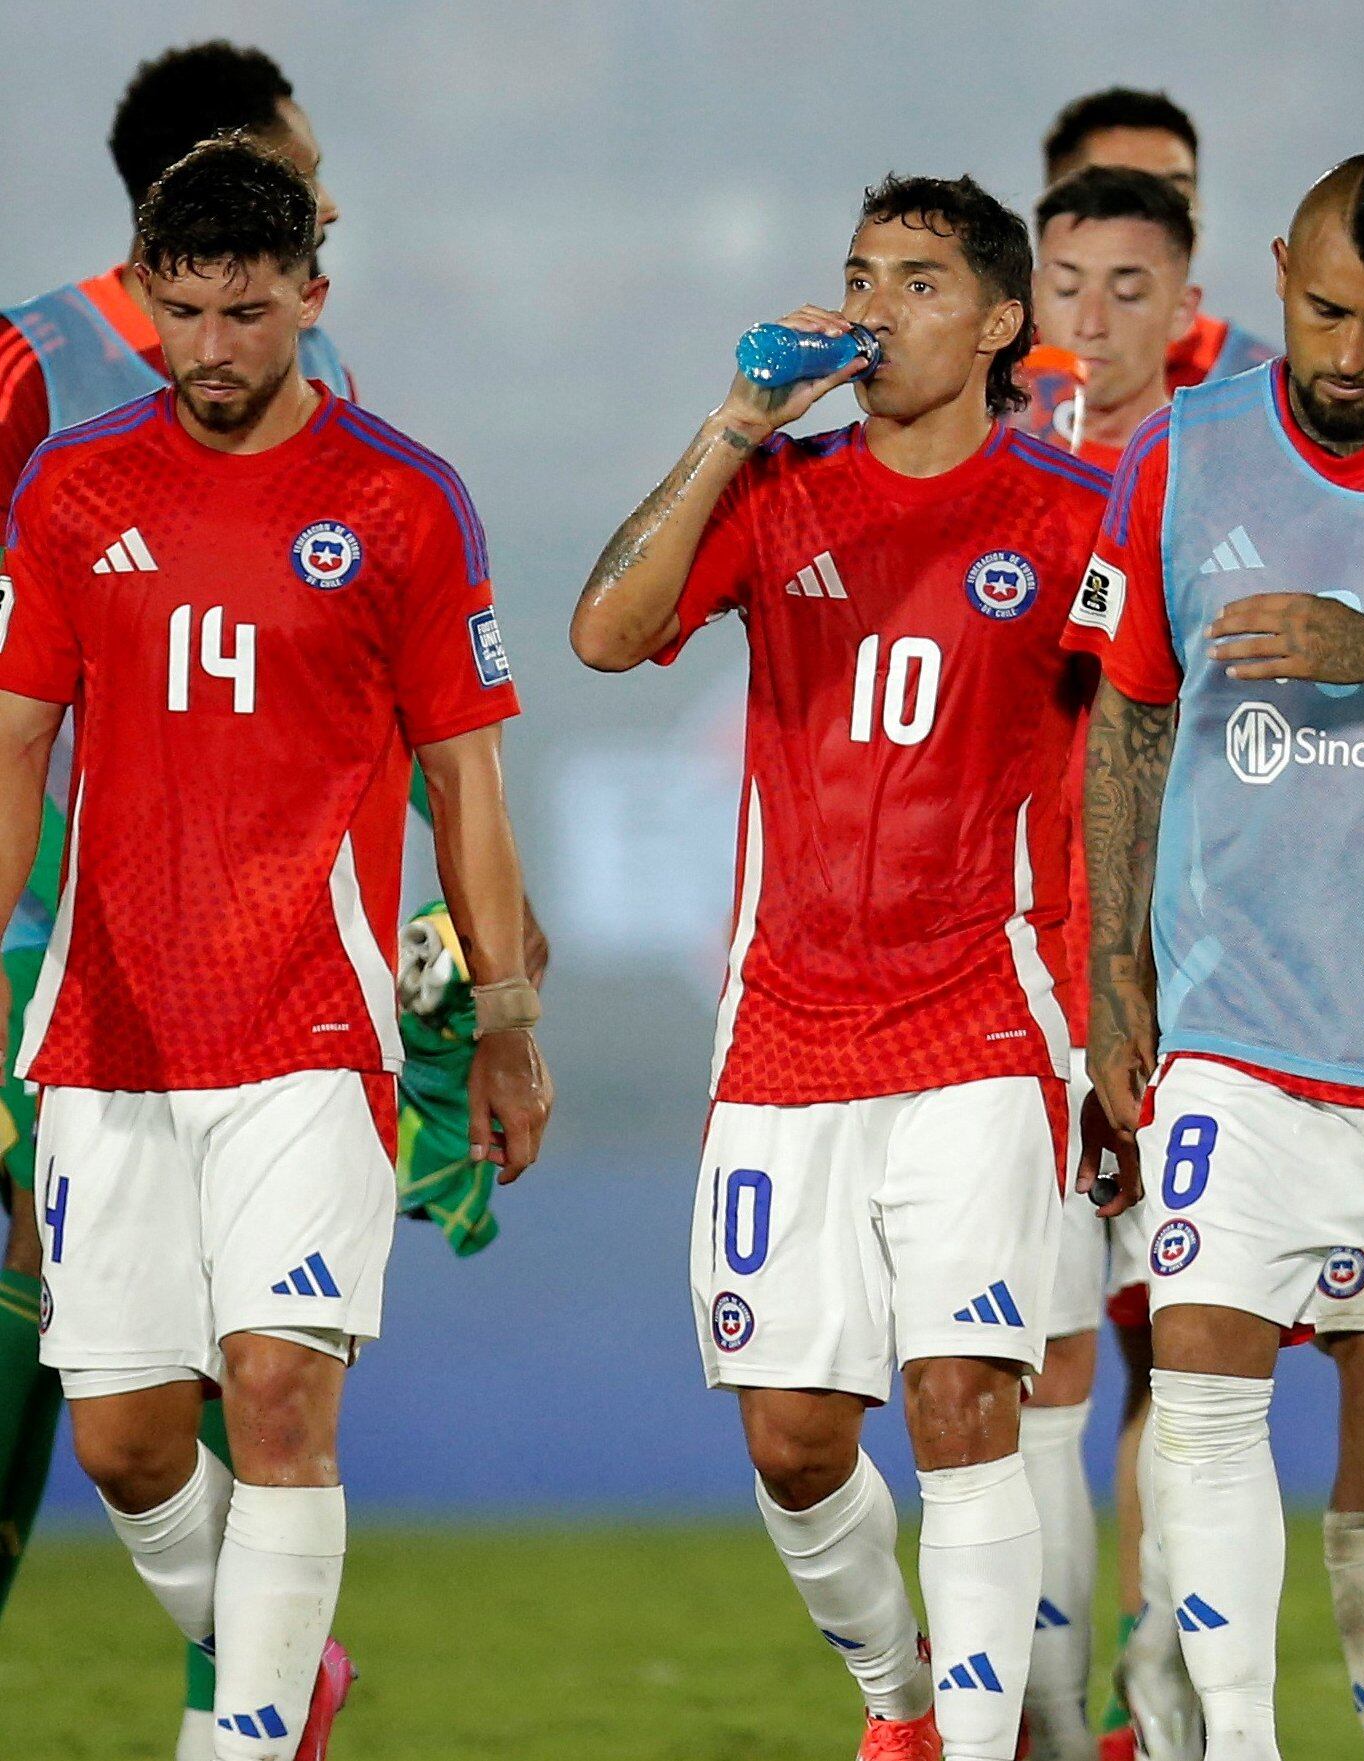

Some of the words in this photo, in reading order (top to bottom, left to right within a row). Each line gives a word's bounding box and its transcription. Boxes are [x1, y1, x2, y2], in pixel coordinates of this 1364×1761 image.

[168, 604, 257, 714] 14
[850, 633, 942, 746] 10
[1231, 708, 1285, 777] MG
[1162, 1114, 1217, 1210] 8
